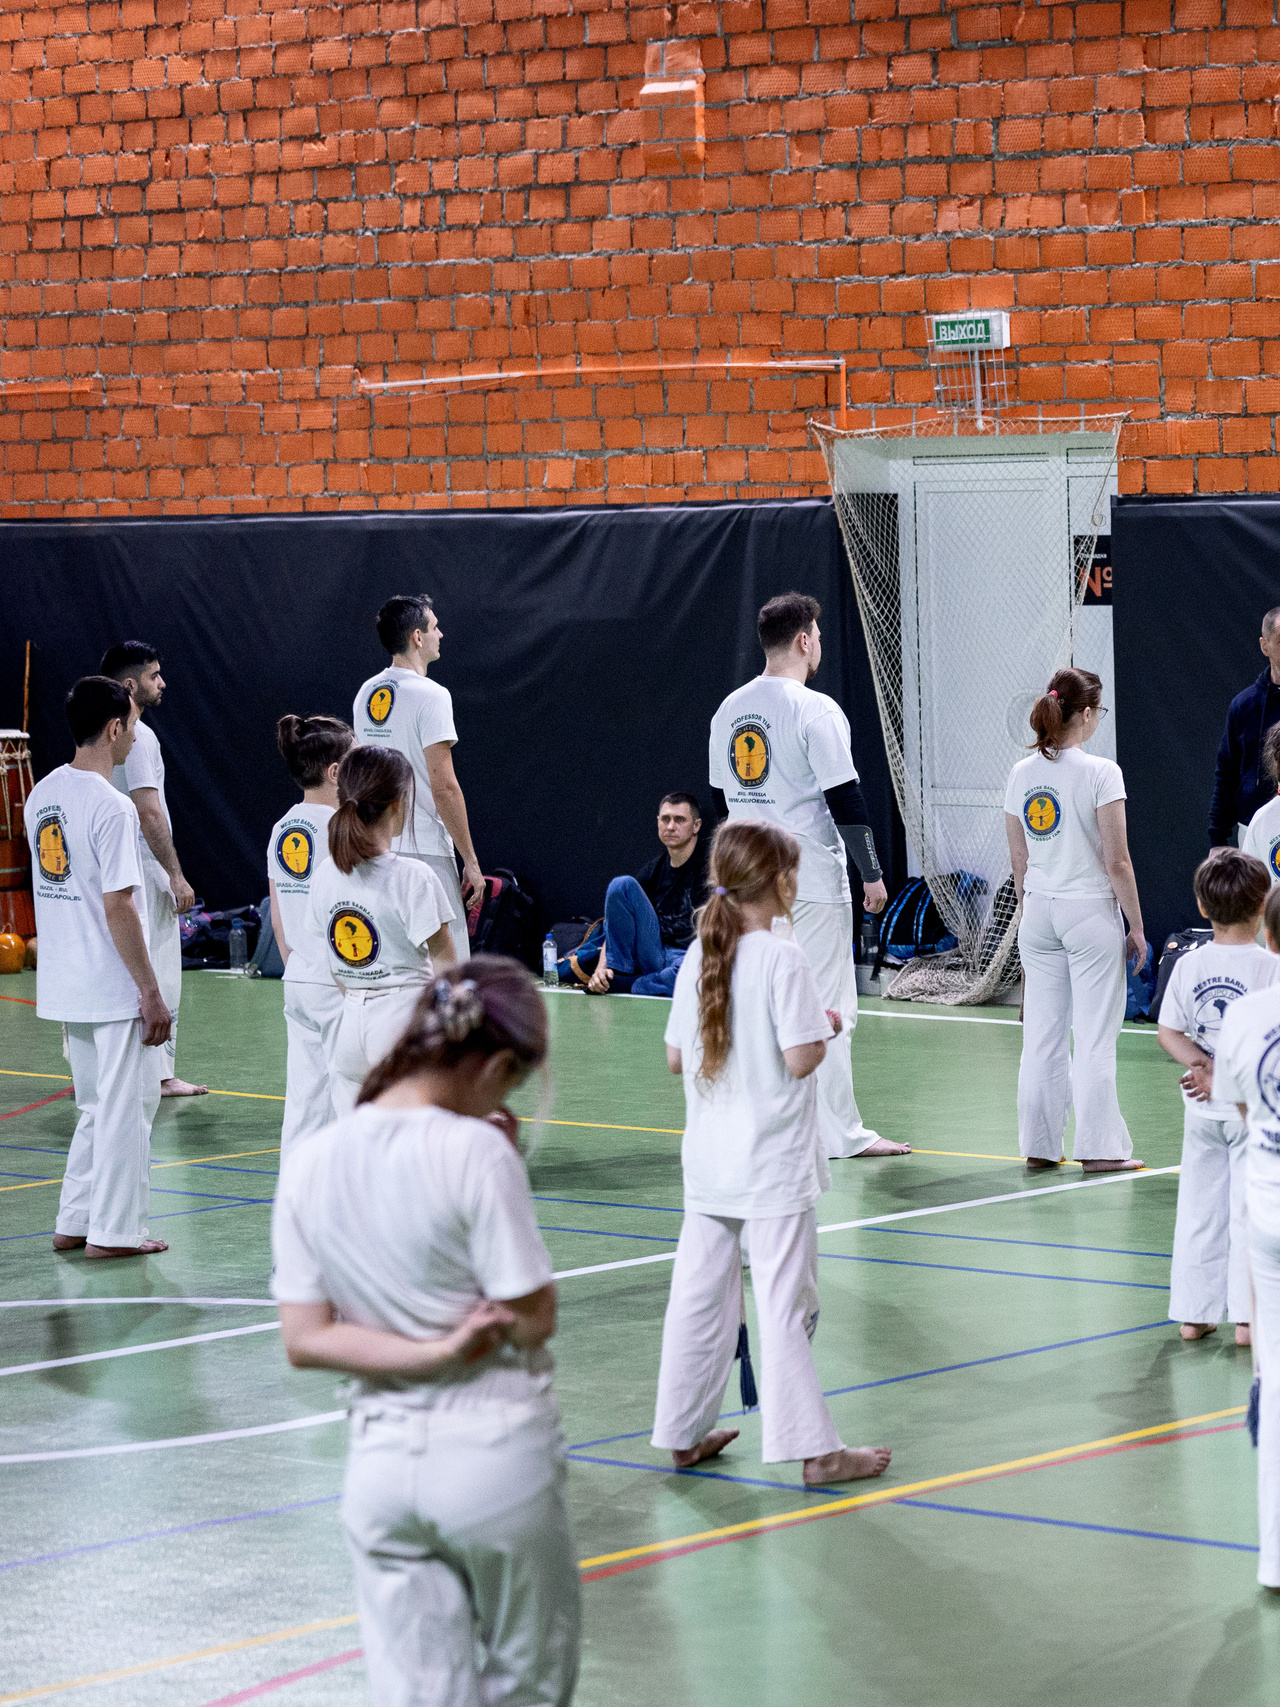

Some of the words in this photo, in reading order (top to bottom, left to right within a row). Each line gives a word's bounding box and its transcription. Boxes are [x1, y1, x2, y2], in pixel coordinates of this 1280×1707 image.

[939, 323, 986, 341] ВЫХОД
[730, 713, 762, 729] PROFESSOR
[280, 818, 300, 830] MESTRE
[1193, 976, 1223, 994] MESTRE
